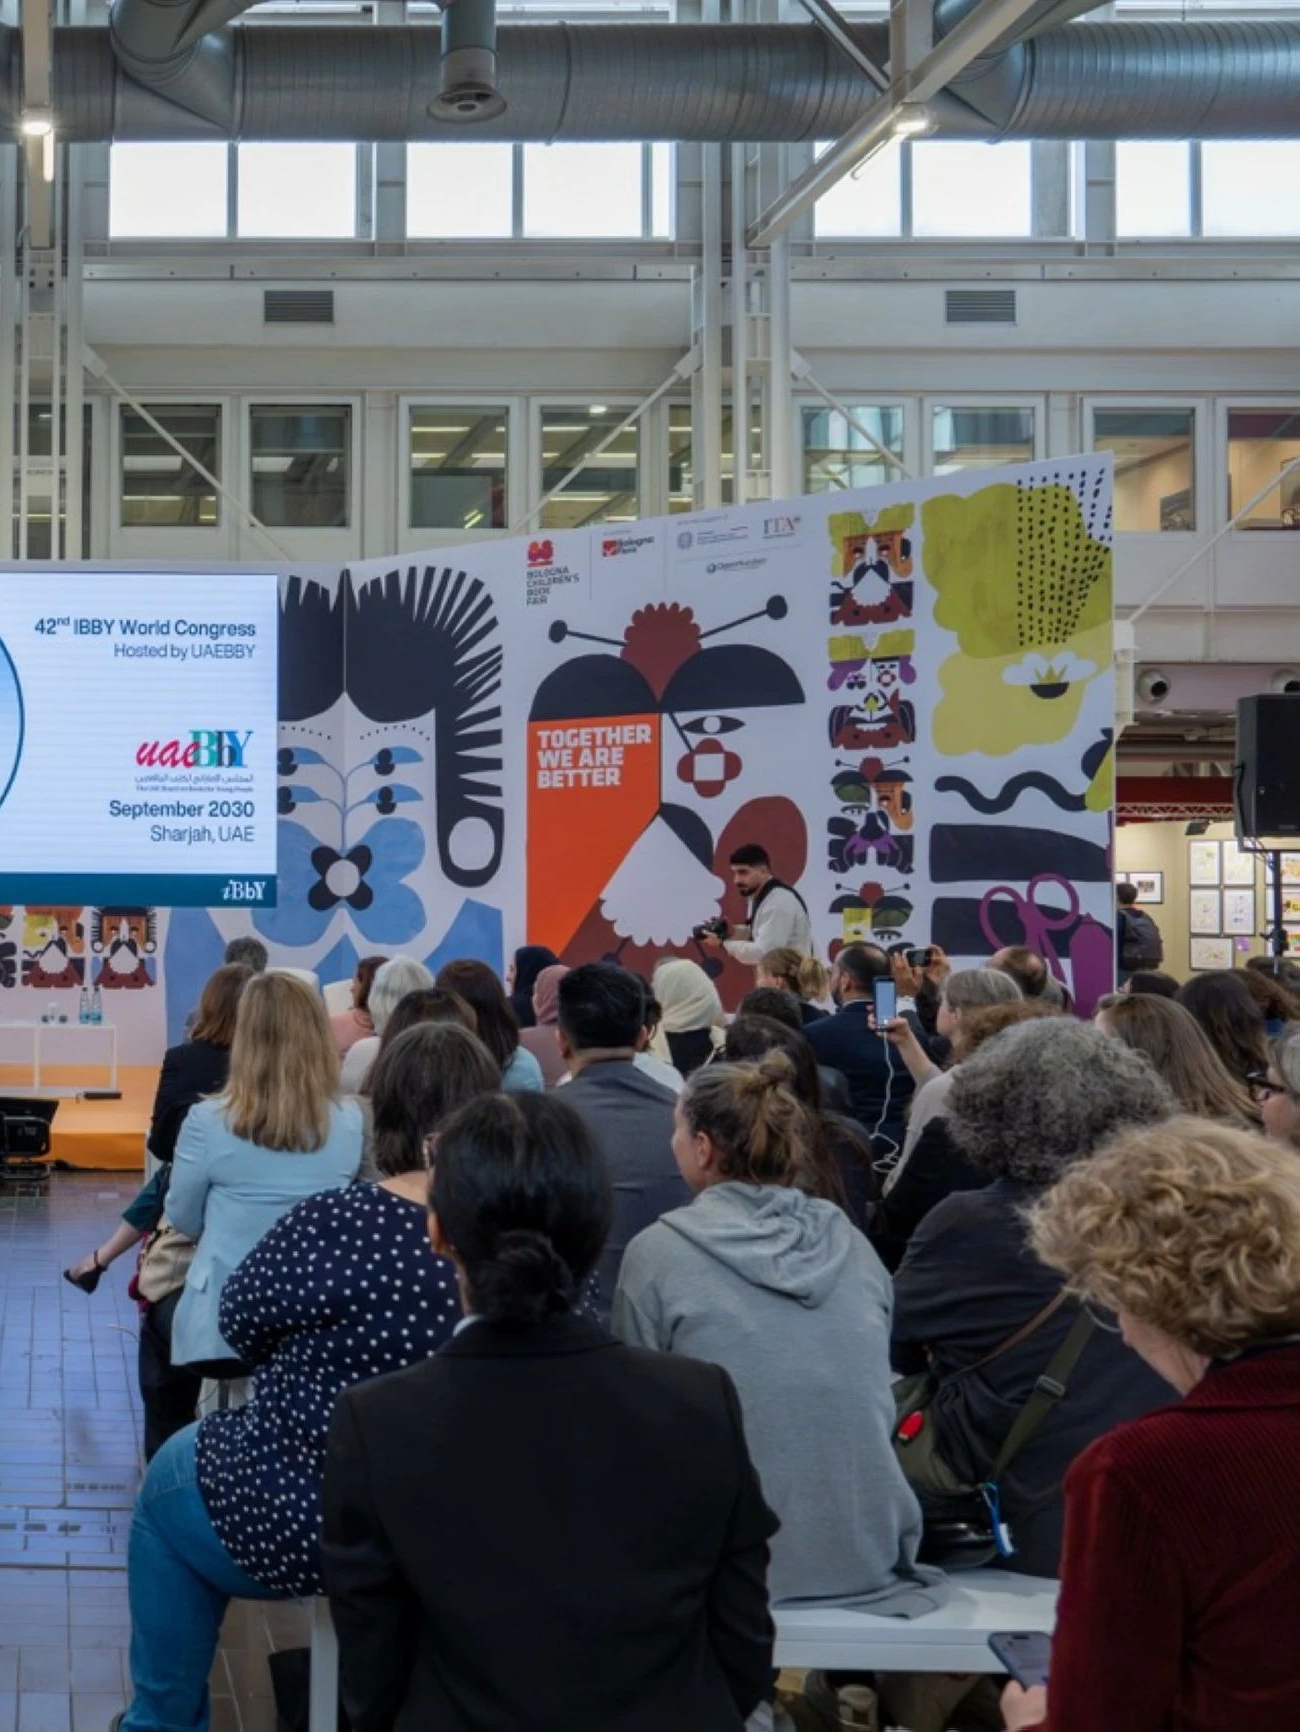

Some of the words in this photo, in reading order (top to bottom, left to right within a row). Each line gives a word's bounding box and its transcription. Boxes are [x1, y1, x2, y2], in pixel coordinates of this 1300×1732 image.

[34, 616, 70, 635] 42nd
[74, 619, 115, 635] IBBY
[119, 619, 170, 635] World
[175, 619, 256, 640] Congress
[114, 643, 168, 658] Hosted
[171, 643, 189, 661] by
[191, 643, 256, 658] UAEBBY
[537, 724, 652, 749] TOGETHER
[537, 750, 573, 769] WE
[578, 747, 624, 767] ARE
[537, 768, 620, 789] BETTER
[109, 800, 204, 820] September
[208, 800, 255, 817] 2030
[150, 824, 216, 845] Sharjah,
[219, 826, 255, 842] UAE
